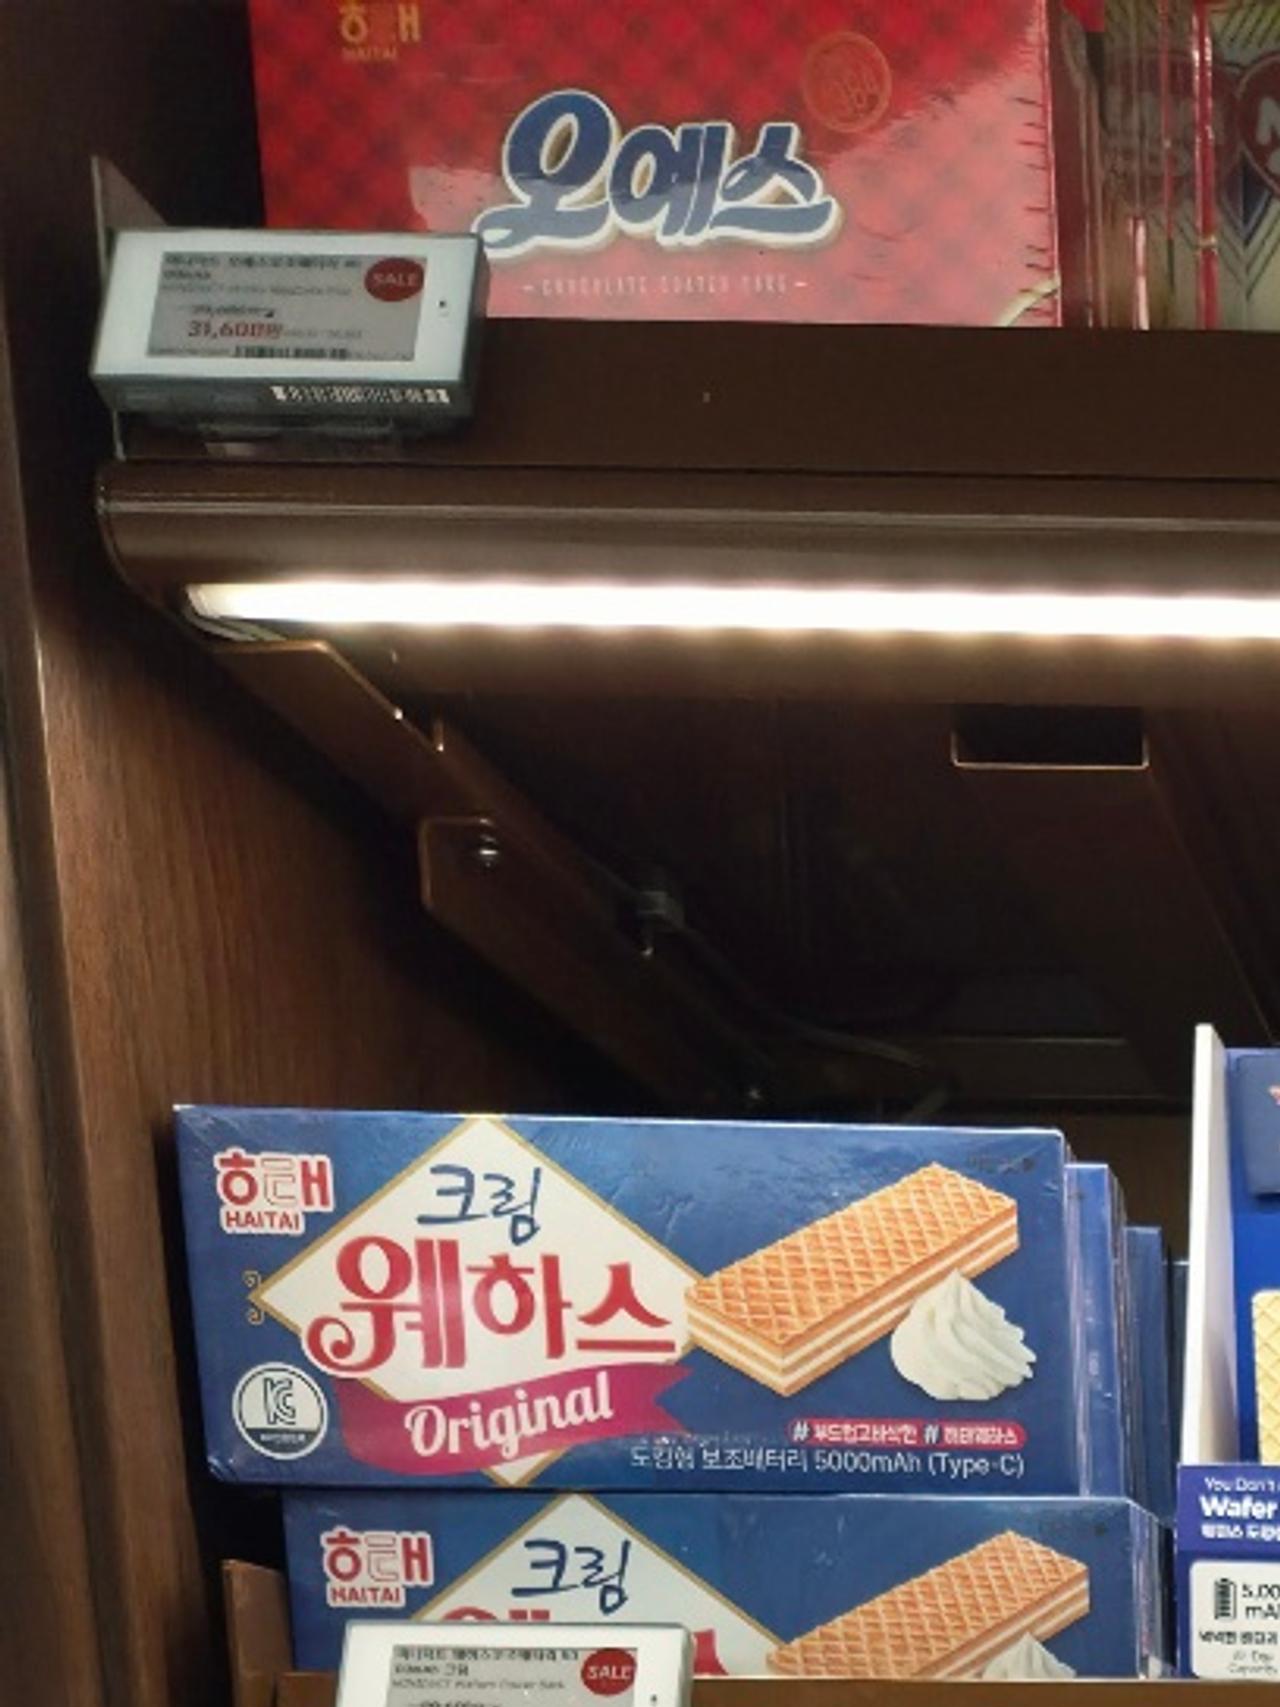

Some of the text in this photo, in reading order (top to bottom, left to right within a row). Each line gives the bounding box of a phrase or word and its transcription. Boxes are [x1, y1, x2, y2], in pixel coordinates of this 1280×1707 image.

[475, 89, 838, 257] 오예스
[371, 272, 417, 288] SALE
[217, 1150, 333, 1211] 해태
[418, 1165, 543, 1243] 크림
[225, 1209, 300, 1232] HAITAI
[308, 1236, 676, 1375] 웨하스
[405, 1371, 613, 1458] Original
[815, 1451, 921, 1472] 5000mAh
[1200, 1496, 1280, 1520] Wafer
[321, 1529, 434, 1587] 해태
[513, 1540, 630, 1613] 크림
[330, 1583, 403, 1605] HAITAI
[587, 1666, 633, 1681] SALE
